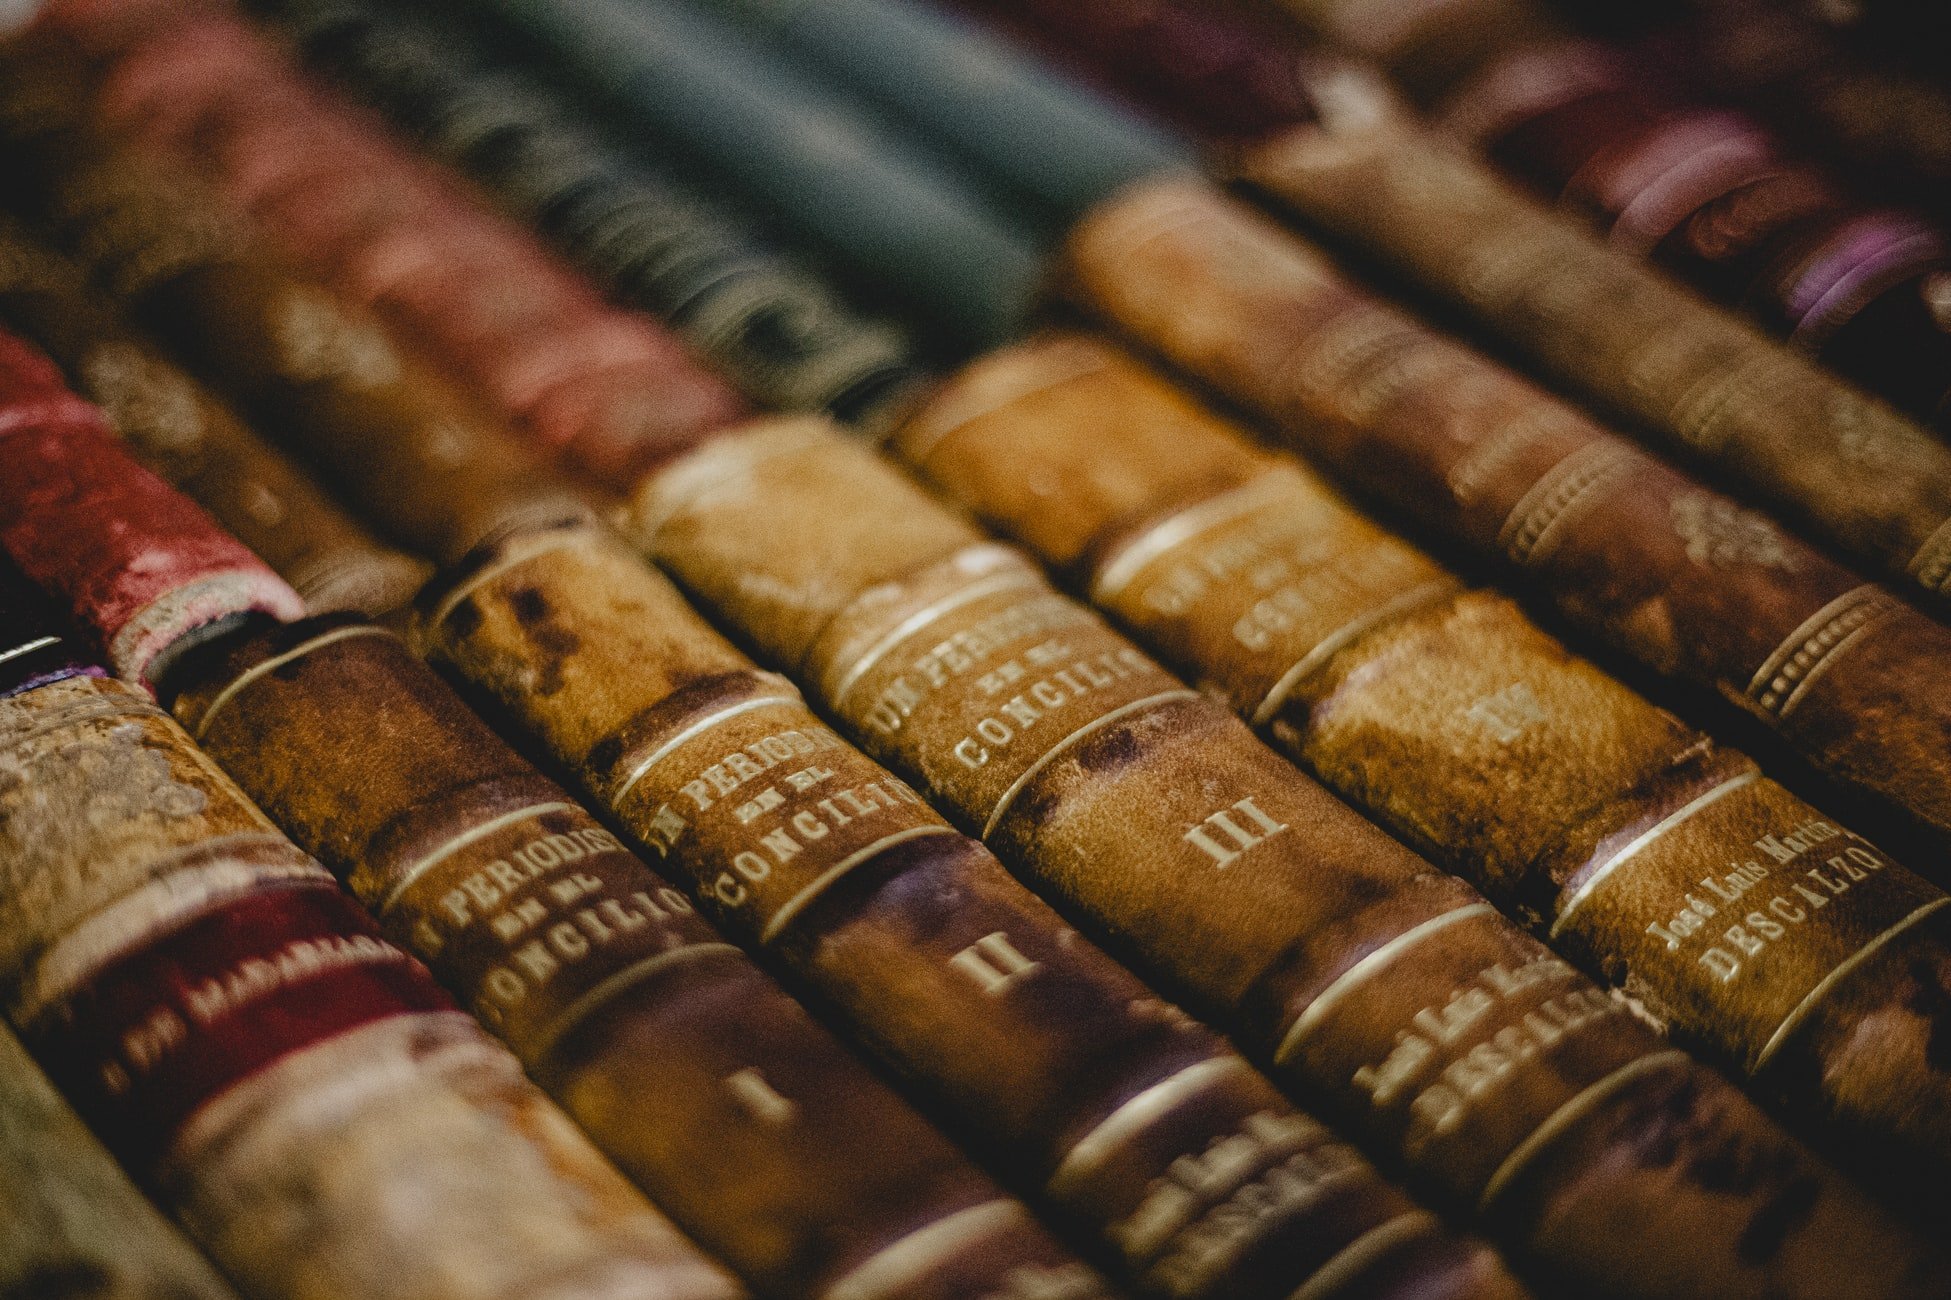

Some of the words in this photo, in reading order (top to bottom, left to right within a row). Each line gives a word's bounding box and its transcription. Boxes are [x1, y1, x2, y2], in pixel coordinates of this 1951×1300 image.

[1183, 795, 1289, 870] III
[440, 828, 627, 928] PERIODIS
[1699, 847, 1886, 984] DESCALZO
[1700, 862, 1769, 902] Luis
[948, 930, 1041, 995] II
